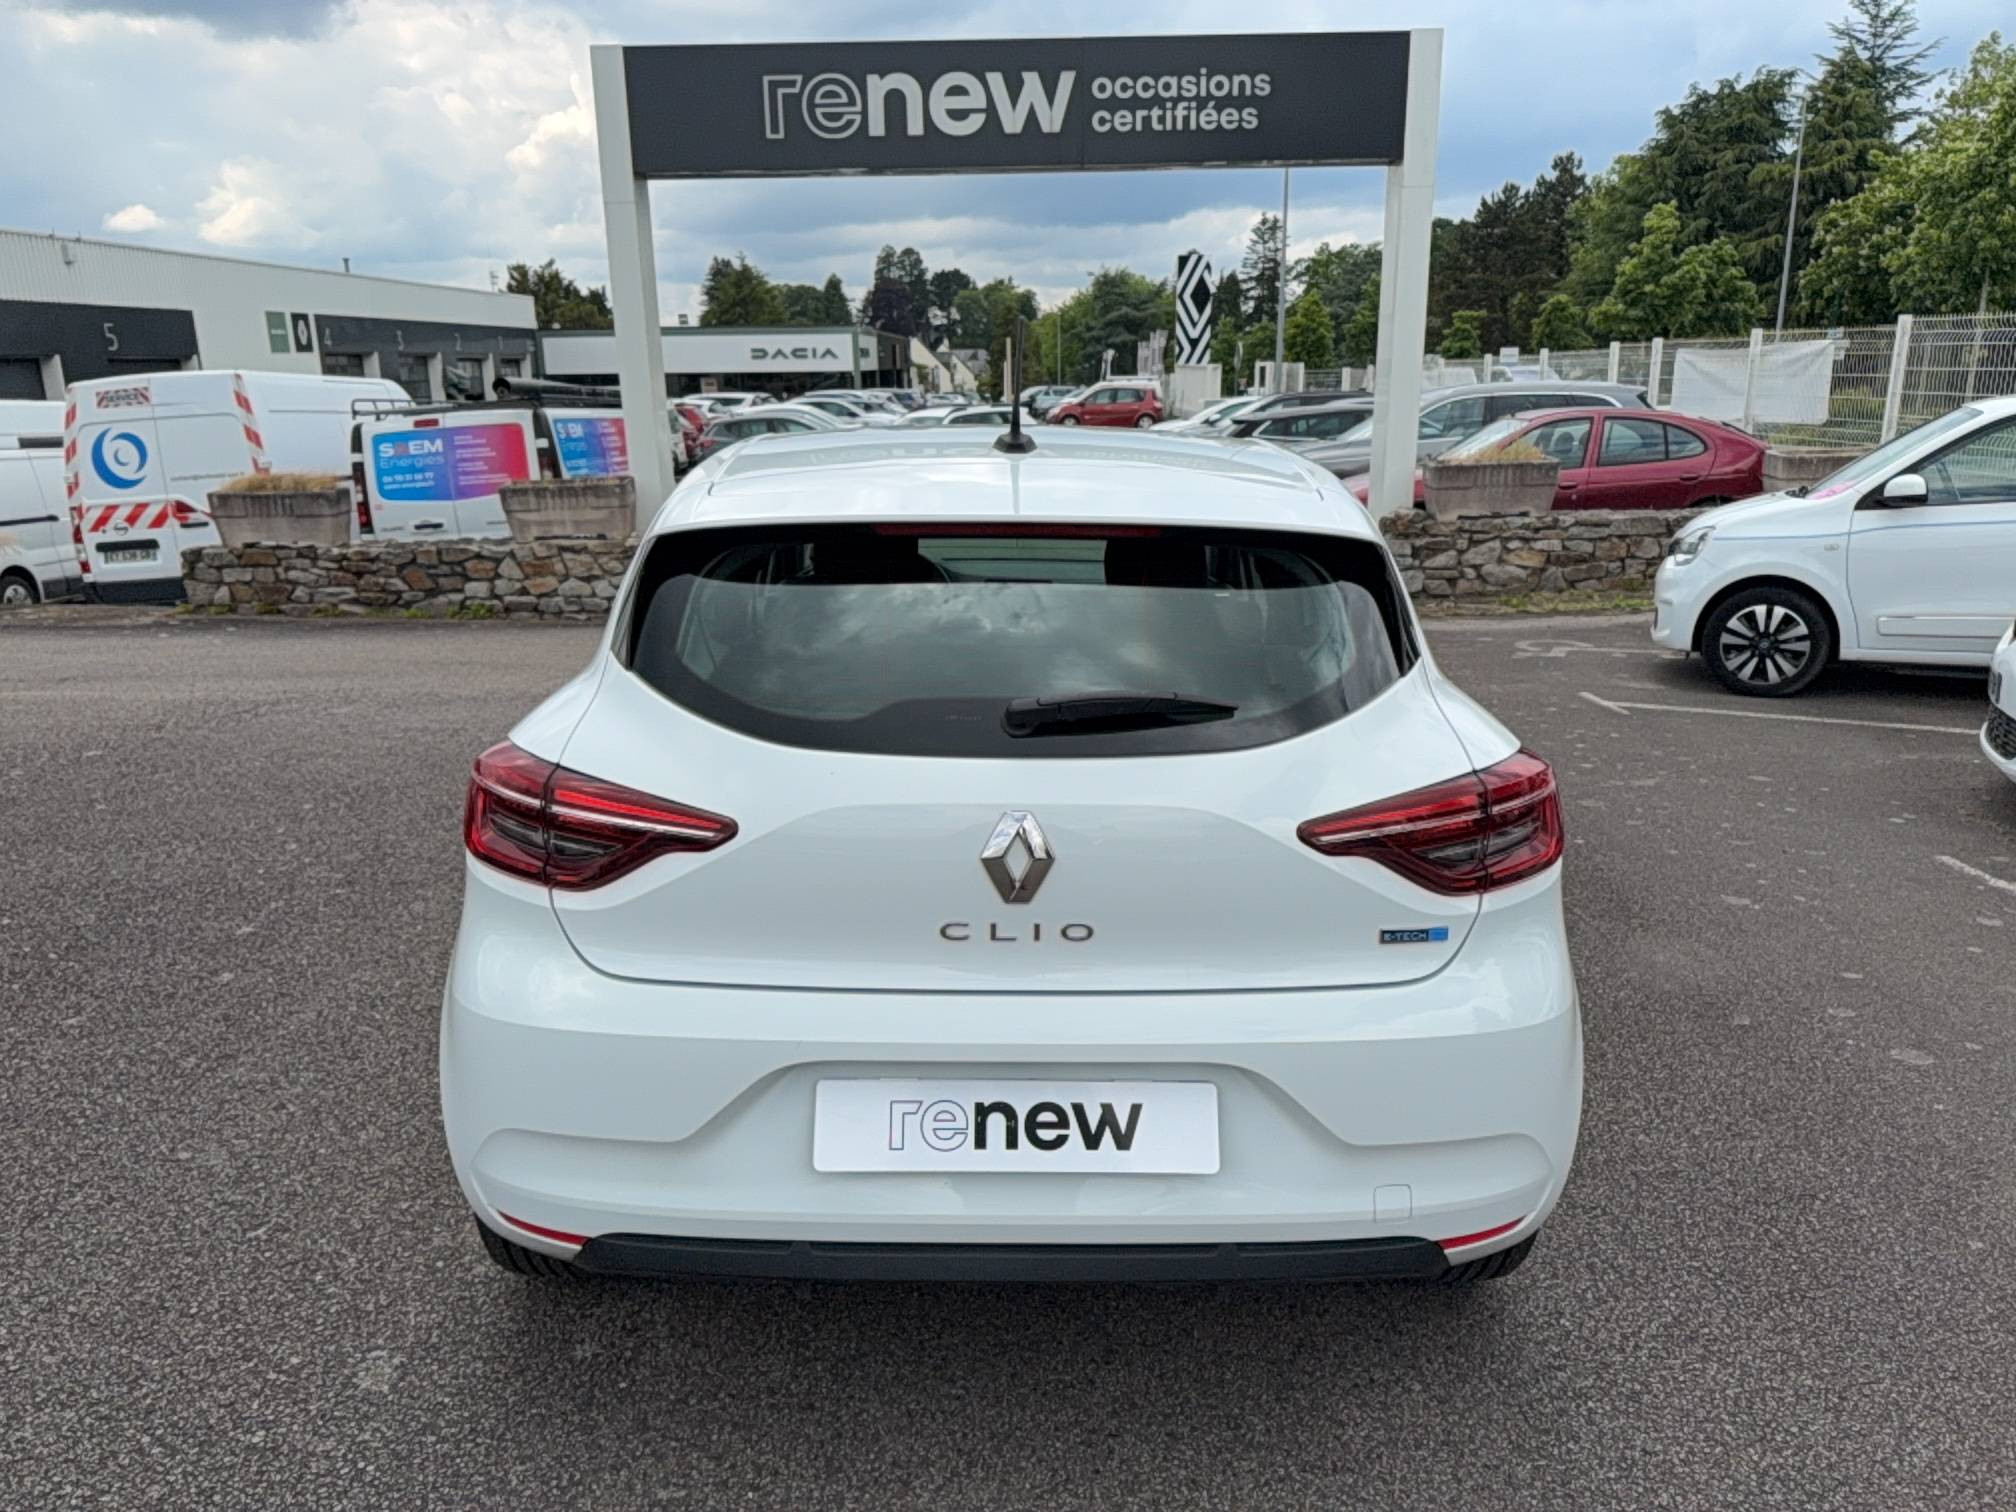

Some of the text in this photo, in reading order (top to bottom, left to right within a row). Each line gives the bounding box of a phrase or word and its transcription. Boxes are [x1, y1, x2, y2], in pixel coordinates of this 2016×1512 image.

[762, 67, 1272, 139] renew occasions
[1091, 101, 1260, 133] certifiées
[103, 322, 119, 352] 5
[750, 347, 839, 360] DACIA
[939, 921, 1095, 943] CLIO
[888, 1100, 1143, 1151] renew
